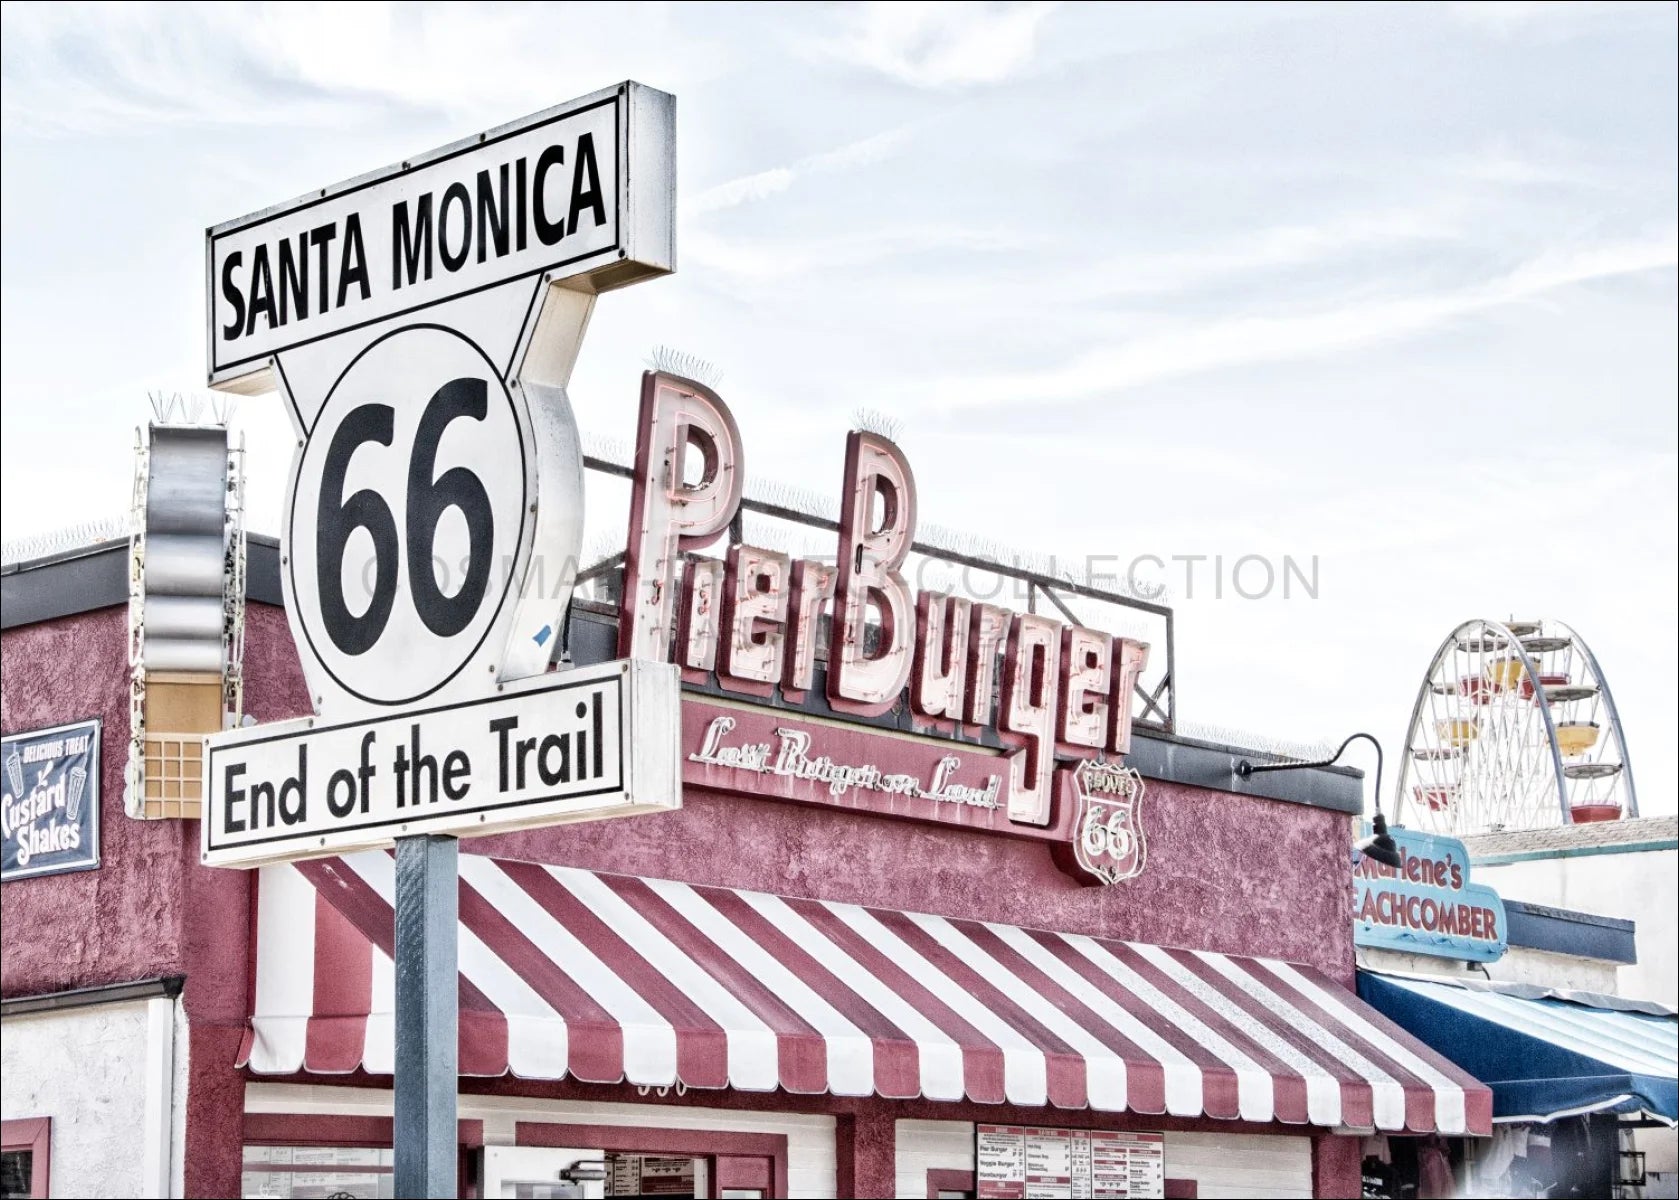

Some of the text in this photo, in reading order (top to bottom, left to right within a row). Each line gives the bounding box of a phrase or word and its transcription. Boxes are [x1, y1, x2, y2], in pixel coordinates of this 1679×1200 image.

[222, 131, 607, 341] SANTA MONICA
[316, 377, 494, 656] 66
[23, 735, 90, 763] DELICIOUS TREAT
[224, 692, 604, 834] End of the Trail
[1, 773, 66, 839] Custard
[1083, 806, 1134, 860] 66
[17, 818, 80, 866] Shakes
